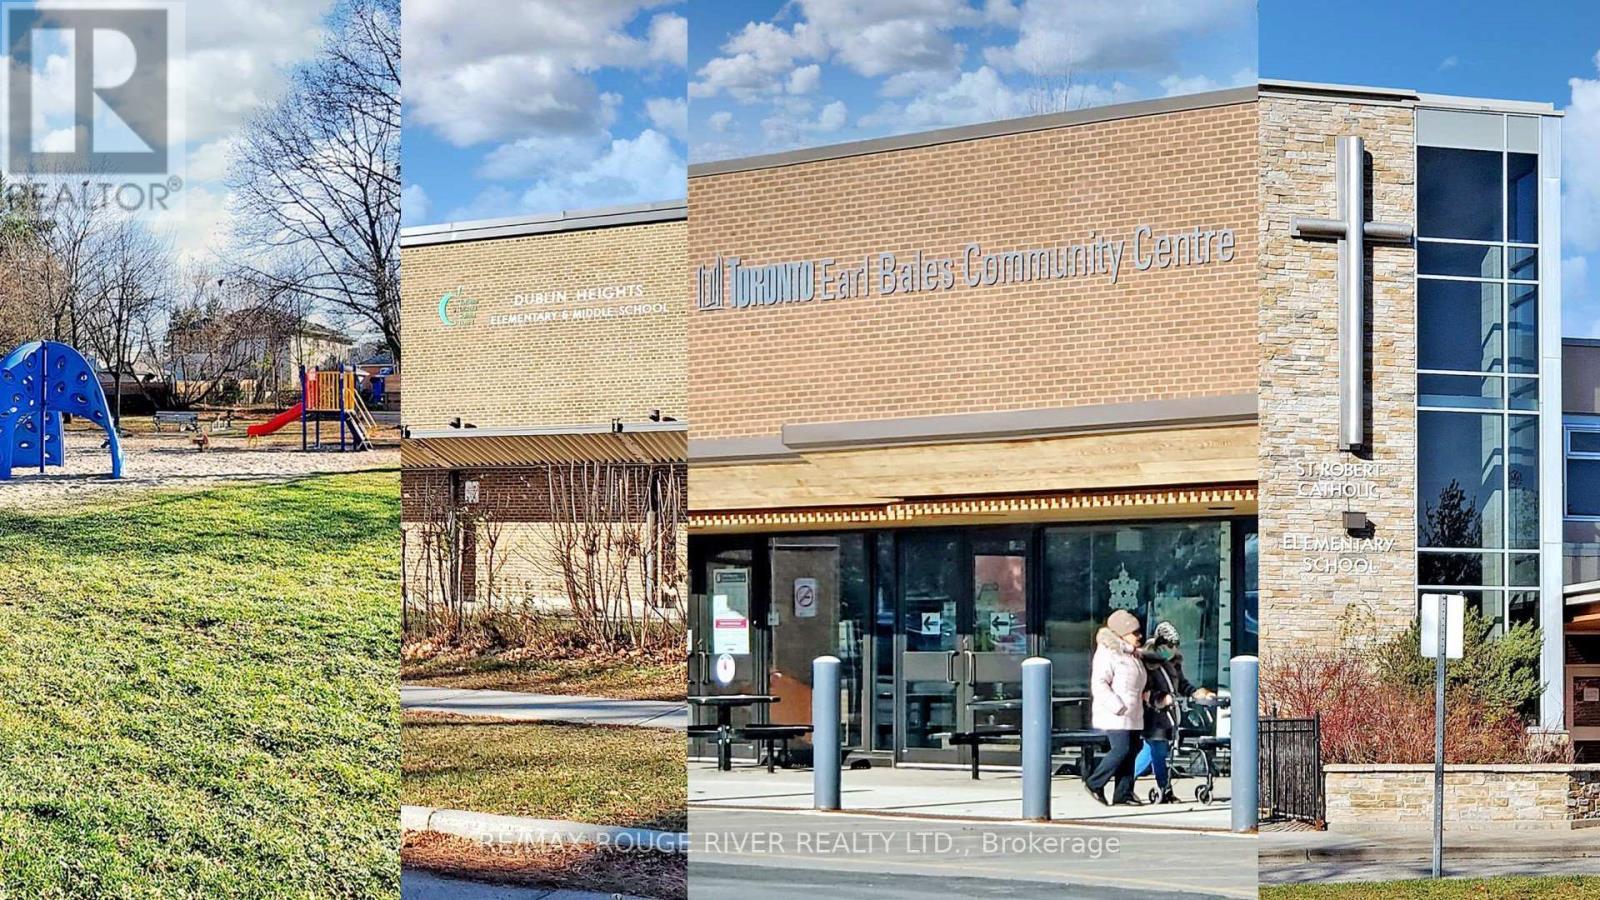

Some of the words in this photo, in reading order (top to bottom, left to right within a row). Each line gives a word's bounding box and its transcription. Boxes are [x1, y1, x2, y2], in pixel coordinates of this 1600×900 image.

[727, 257, 816, 308] TORONTO
[821, 255, 870, 301] Earl
[879, 250, 955, 296] Bales
[963, 230, 1125, 287] Community
[1135, 224, 1236, 271] Centre
[513, 290, 566, 306] DUBLIN
[576, 284, 644, 301] HEIGHTS
[489, 310, 559, 325] ELEMENTARY
[562, 308, 569, 320] &
[572, 307, 613, 319] MIDDLE
[618, 302, 670, 316] SCHOOL
[1297, 481, 1381, 498] CATHOLIC
[1283, 533, 1395, 553] ELEMENTARY
[1303, 557, 1379, 575] SCHOOL
